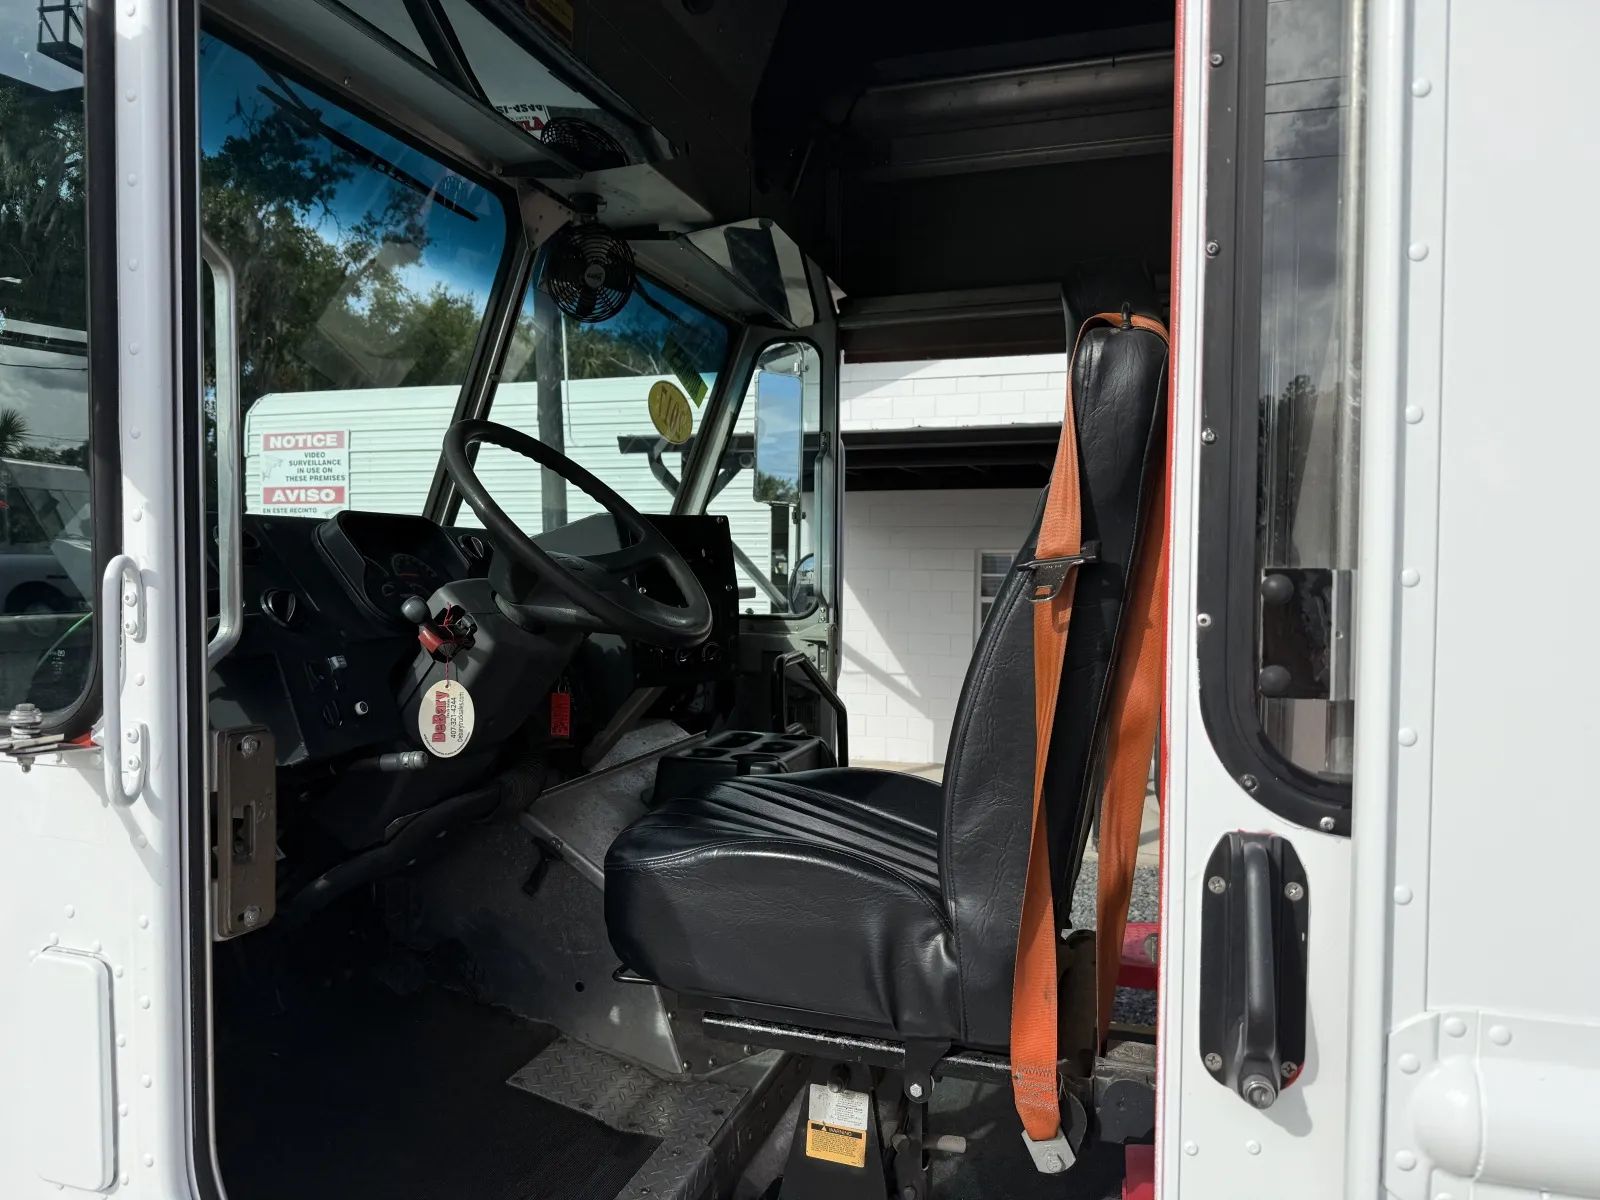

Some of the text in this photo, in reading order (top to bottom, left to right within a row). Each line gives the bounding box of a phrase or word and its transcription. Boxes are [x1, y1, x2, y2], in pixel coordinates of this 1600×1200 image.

[269, 433, 338, 449] NOTICE
[304, 451, 326, 459] VIDEO
[288, 459, 342, 467] SURVEILLANCE
[306, 466, 320, 474] USE
[309, 474, 346, 482] PREMISES
[271, 488, 336, 503] AVISO
[431, 690, 450, 743] DeBary
